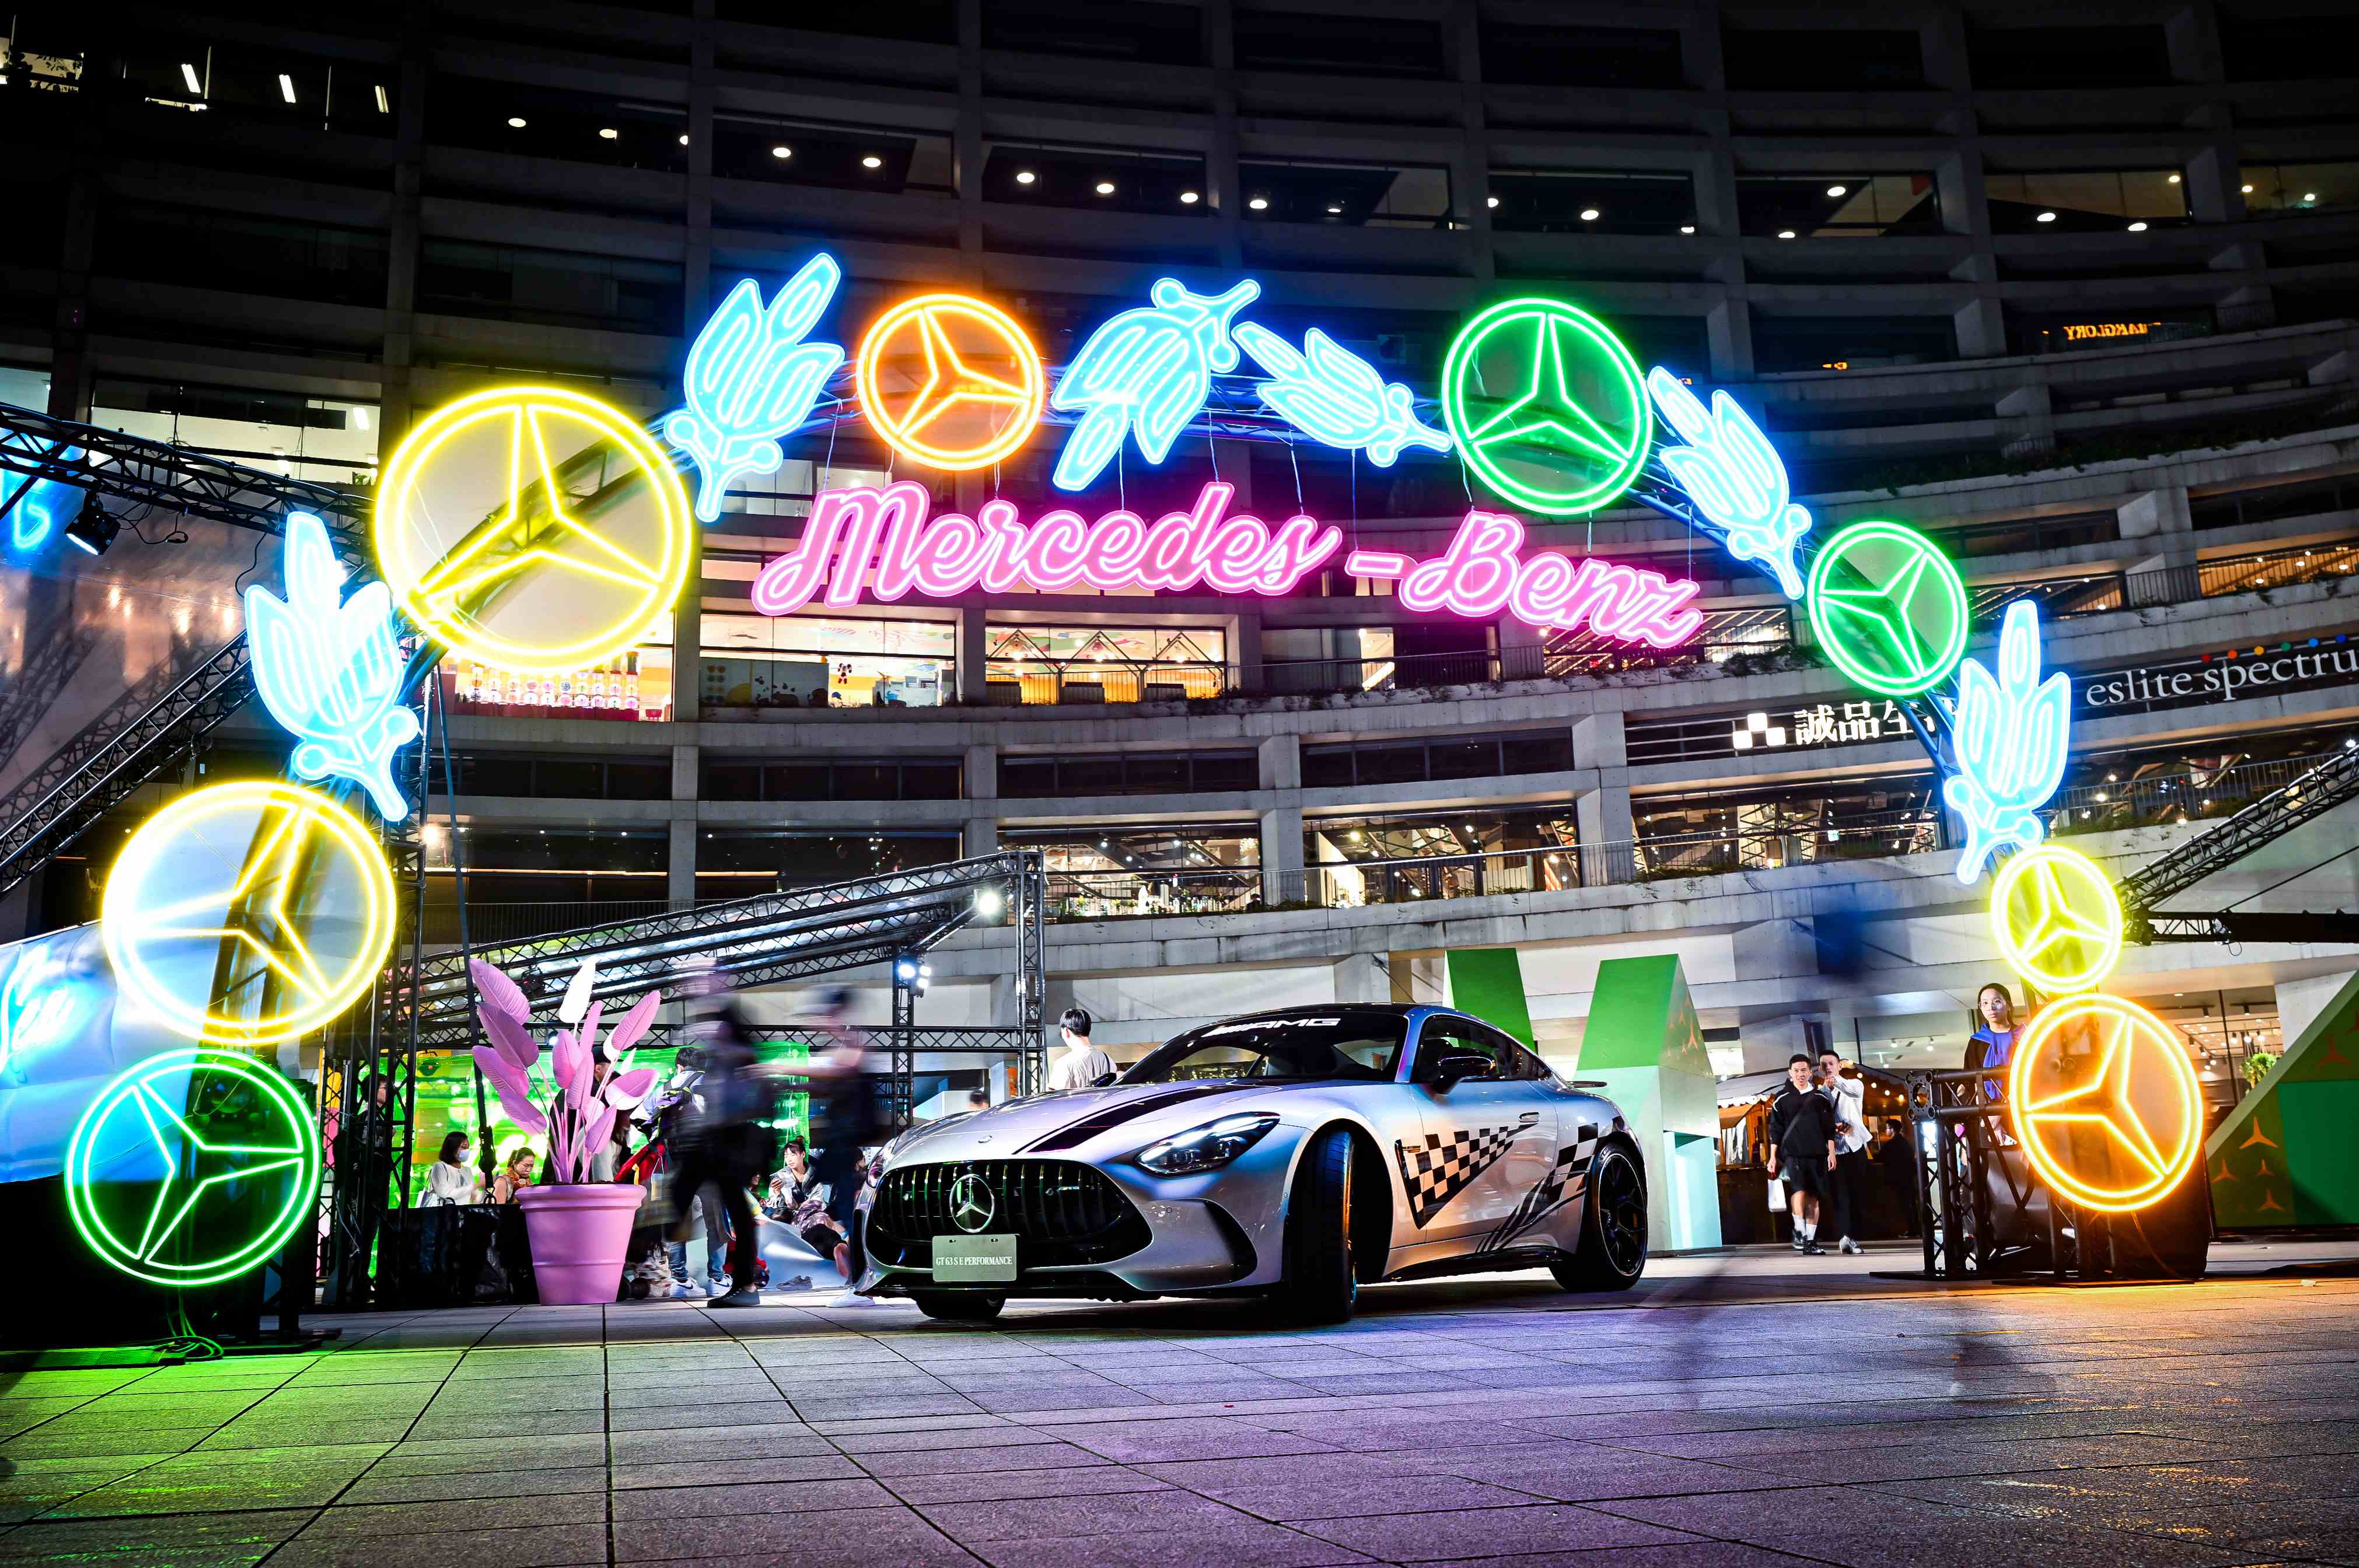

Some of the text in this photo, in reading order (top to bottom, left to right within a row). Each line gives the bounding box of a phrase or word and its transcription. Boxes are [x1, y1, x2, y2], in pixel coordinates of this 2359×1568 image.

[2086, 648, 2359, 706] eslite spectru
[1793, 699, 1956, 746] 誠品生
[935, 1256, 1013, 1266] GT 63 S E PERFORMANCE
